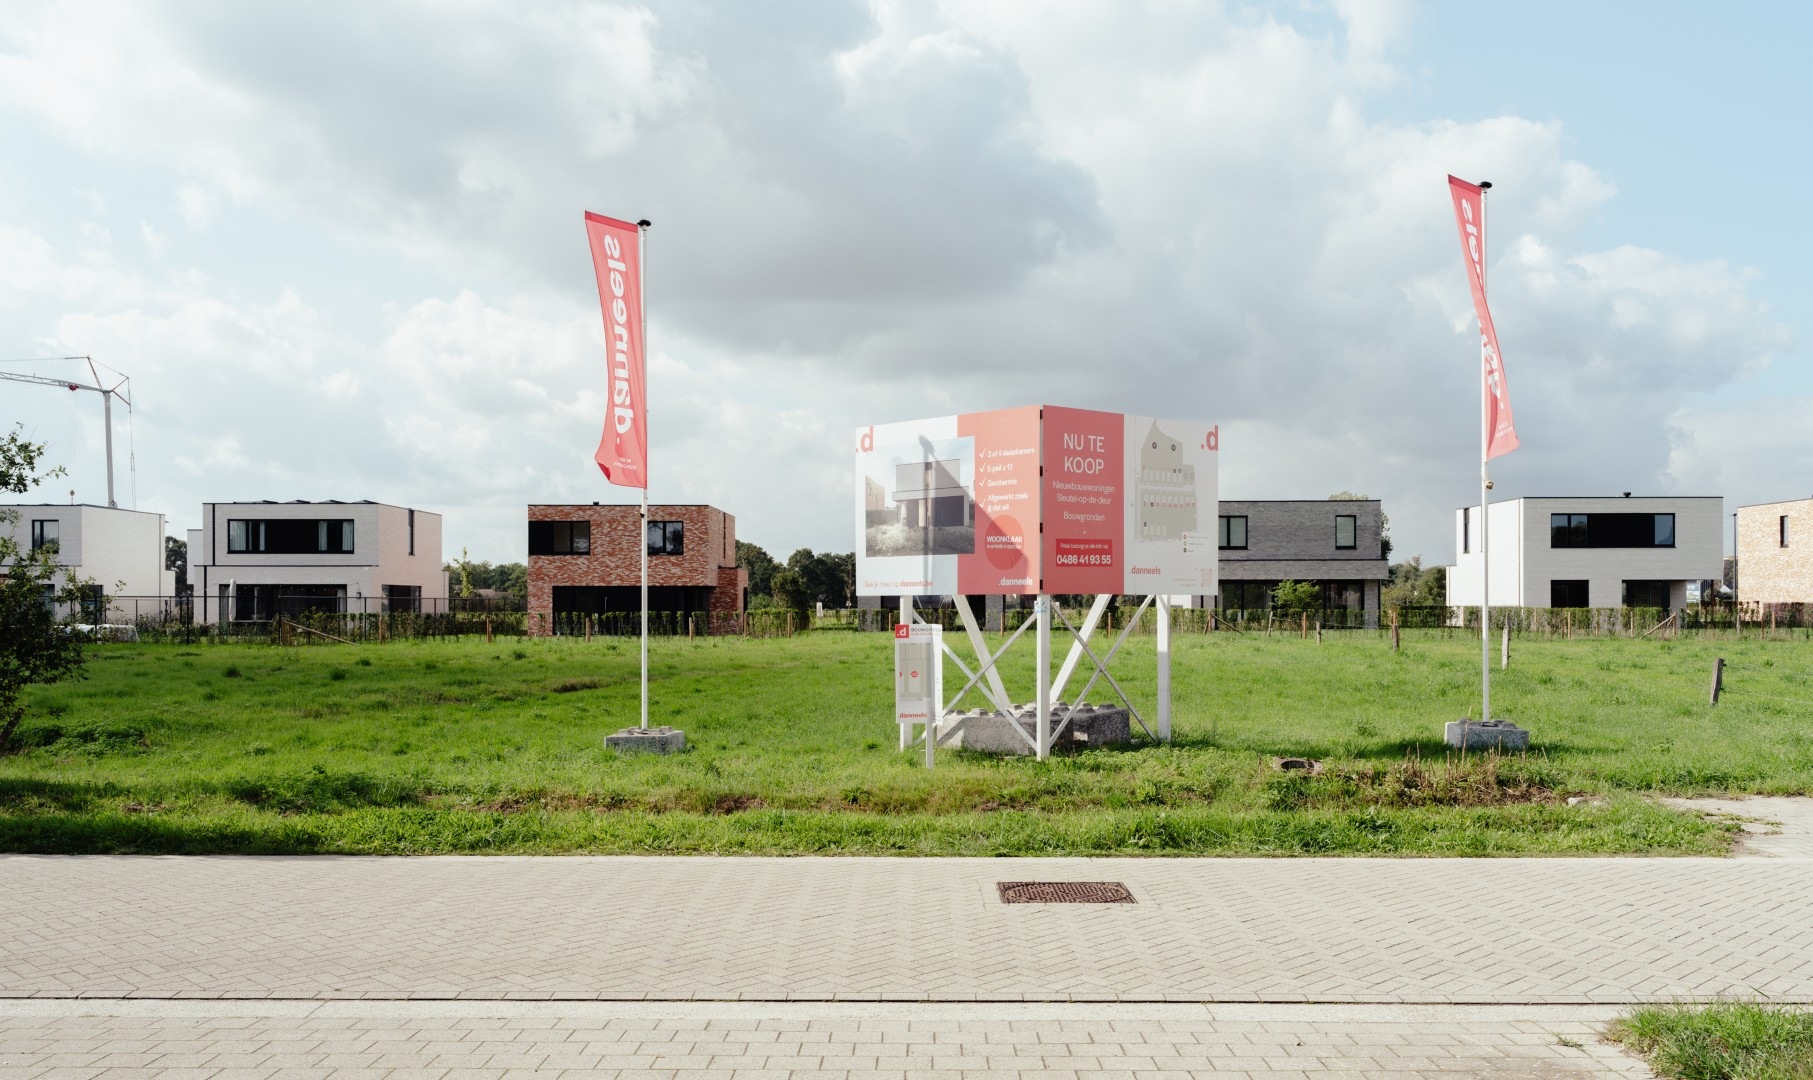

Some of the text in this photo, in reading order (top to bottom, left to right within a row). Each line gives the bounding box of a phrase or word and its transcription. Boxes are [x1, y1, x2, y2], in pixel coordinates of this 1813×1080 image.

[1063, 432, 1105, 453] NU TE
[1200, 425, 1219, 452] .d
[1063, 455, 1105, 475] KOOP
[987, 479, 1018, 487] Geothermie
[1052, 480, 1116, 495] Nieuwbouwwoningen
[1056, 493, 1112, 505] Sleutel-op-de-deur
[1063, 511, 1106, 523] Bouwgronden
[986, 536, 1023, 544] WOONKLAAR
[1056, 554, 1112, 565] 0486 41 93 55
[1129, 565, 1161, 576] .danneels
[998, 576, 1033, 586] .danneels
[896, 626, 907, 637] .d
